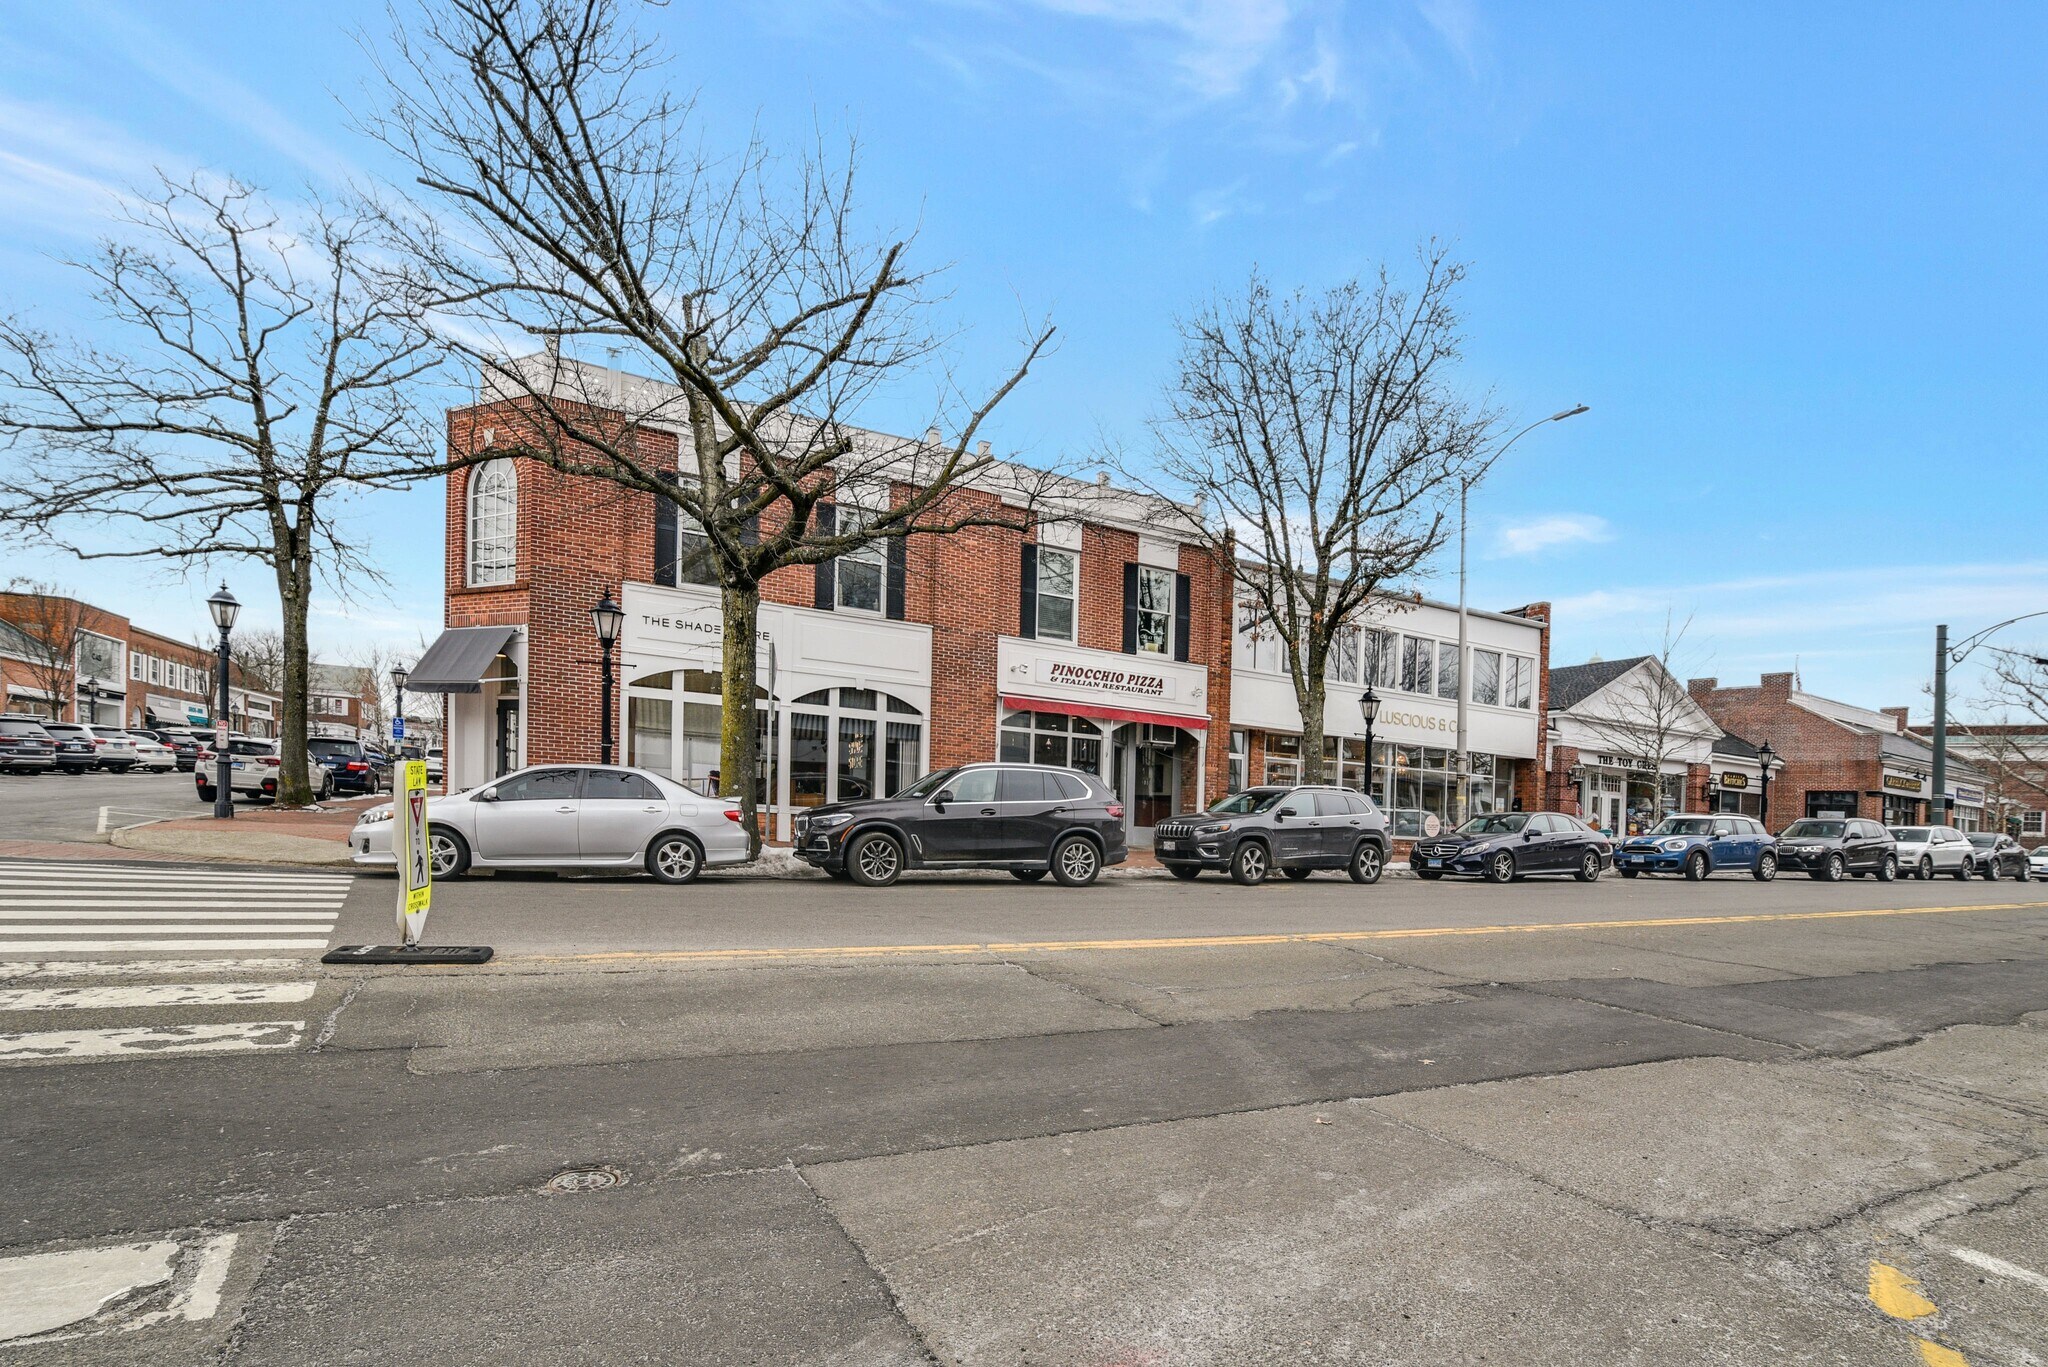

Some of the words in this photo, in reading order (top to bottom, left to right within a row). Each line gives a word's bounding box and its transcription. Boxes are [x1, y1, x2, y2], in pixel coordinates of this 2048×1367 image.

[642, 615, 669, 628] THE
[675, 619, 721, 635] SHADE
[1050, 663, 1125, 683] PINOCCHIO
[1127, 674, 1163, 689] PIZZA
[1060, 677, 1100, 688] ITALIAN
[1102, 683, 1163, 696] RESTAURANT
[1379, 710, 1436, 730] LUSCIOUS
[1438, 718, 1446, 731] &
[1449, 720, 1457, 733] C
[1597, 755, 1614, 765] THE
[1617, 757, 1633, 768] TOY
[410, 765, 423, 775] STATE
[413, 777, 422, 787] LAW
[408, 899, 428, 911] CROSSWALK
